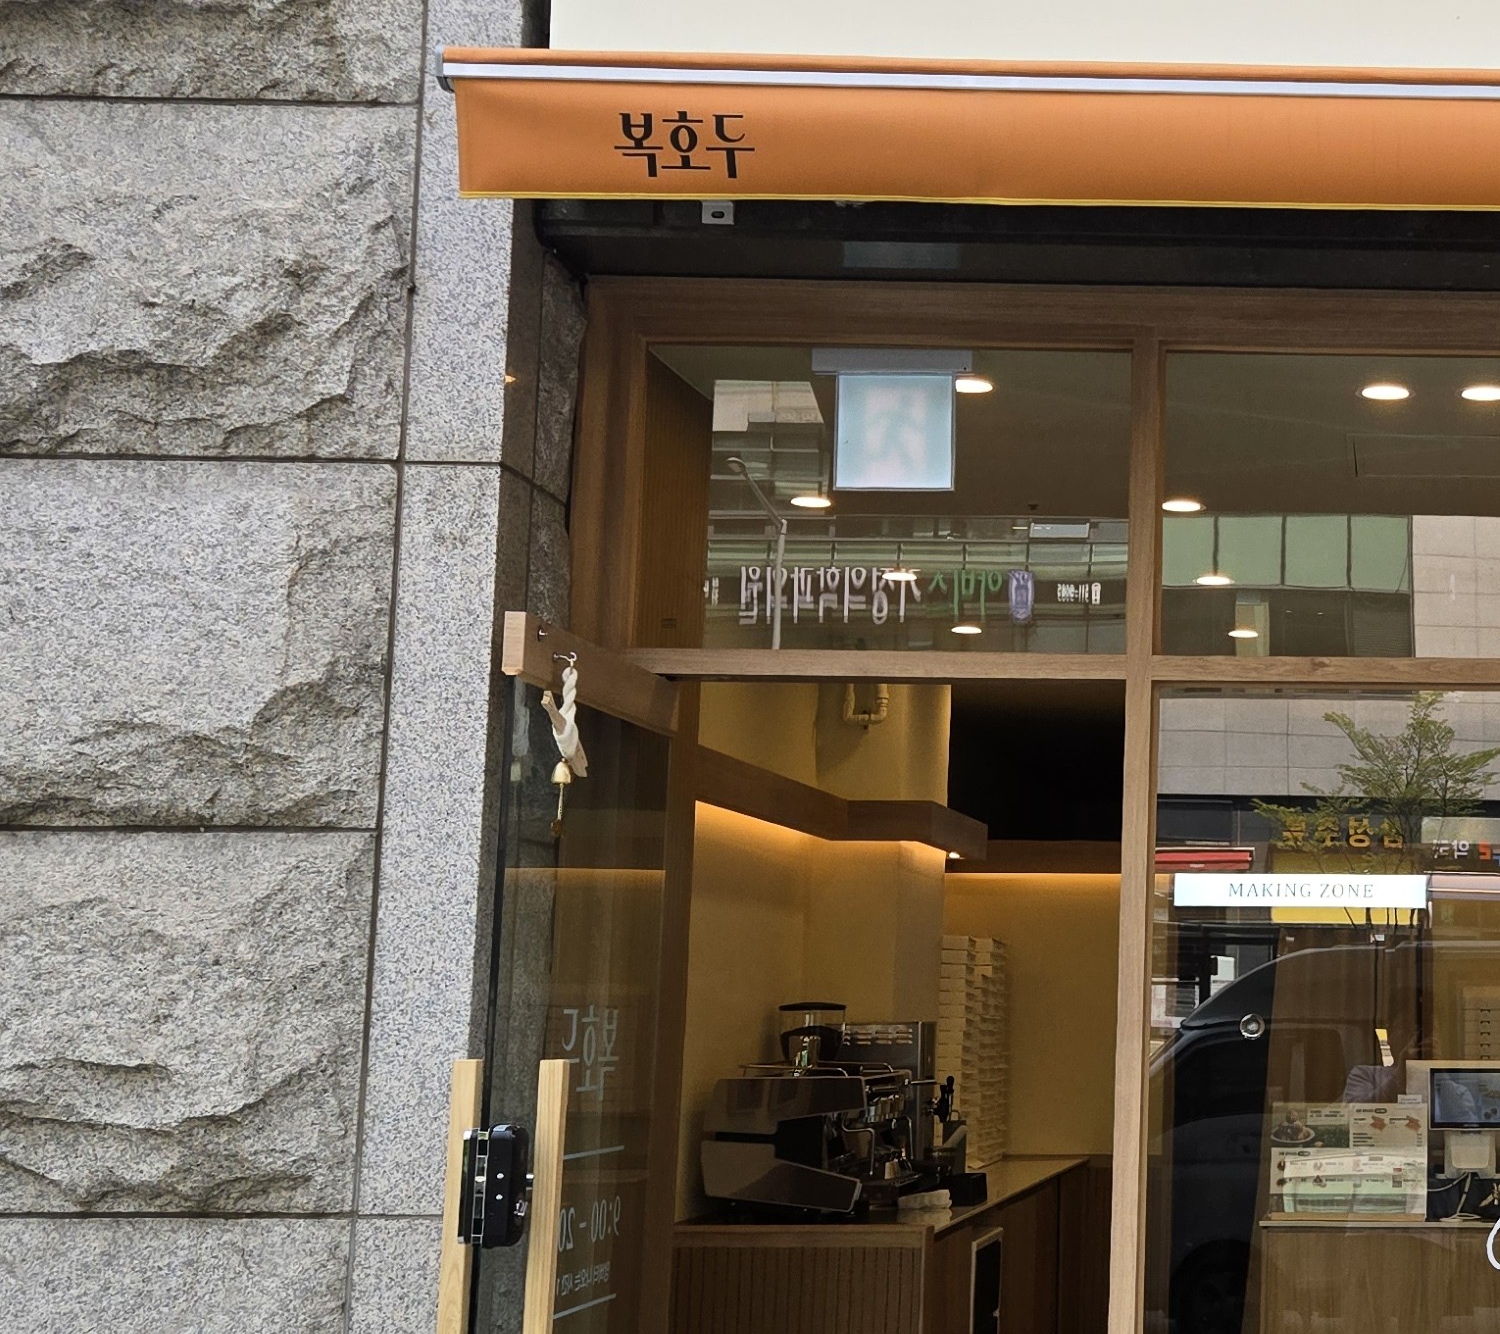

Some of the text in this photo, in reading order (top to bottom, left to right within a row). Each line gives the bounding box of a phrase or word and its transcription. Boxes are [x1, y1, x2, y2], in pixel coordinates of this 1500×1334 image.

[613, 109, 756, 180] 복호두
[1227, 882, 1375, 900] MAKING ZONE
